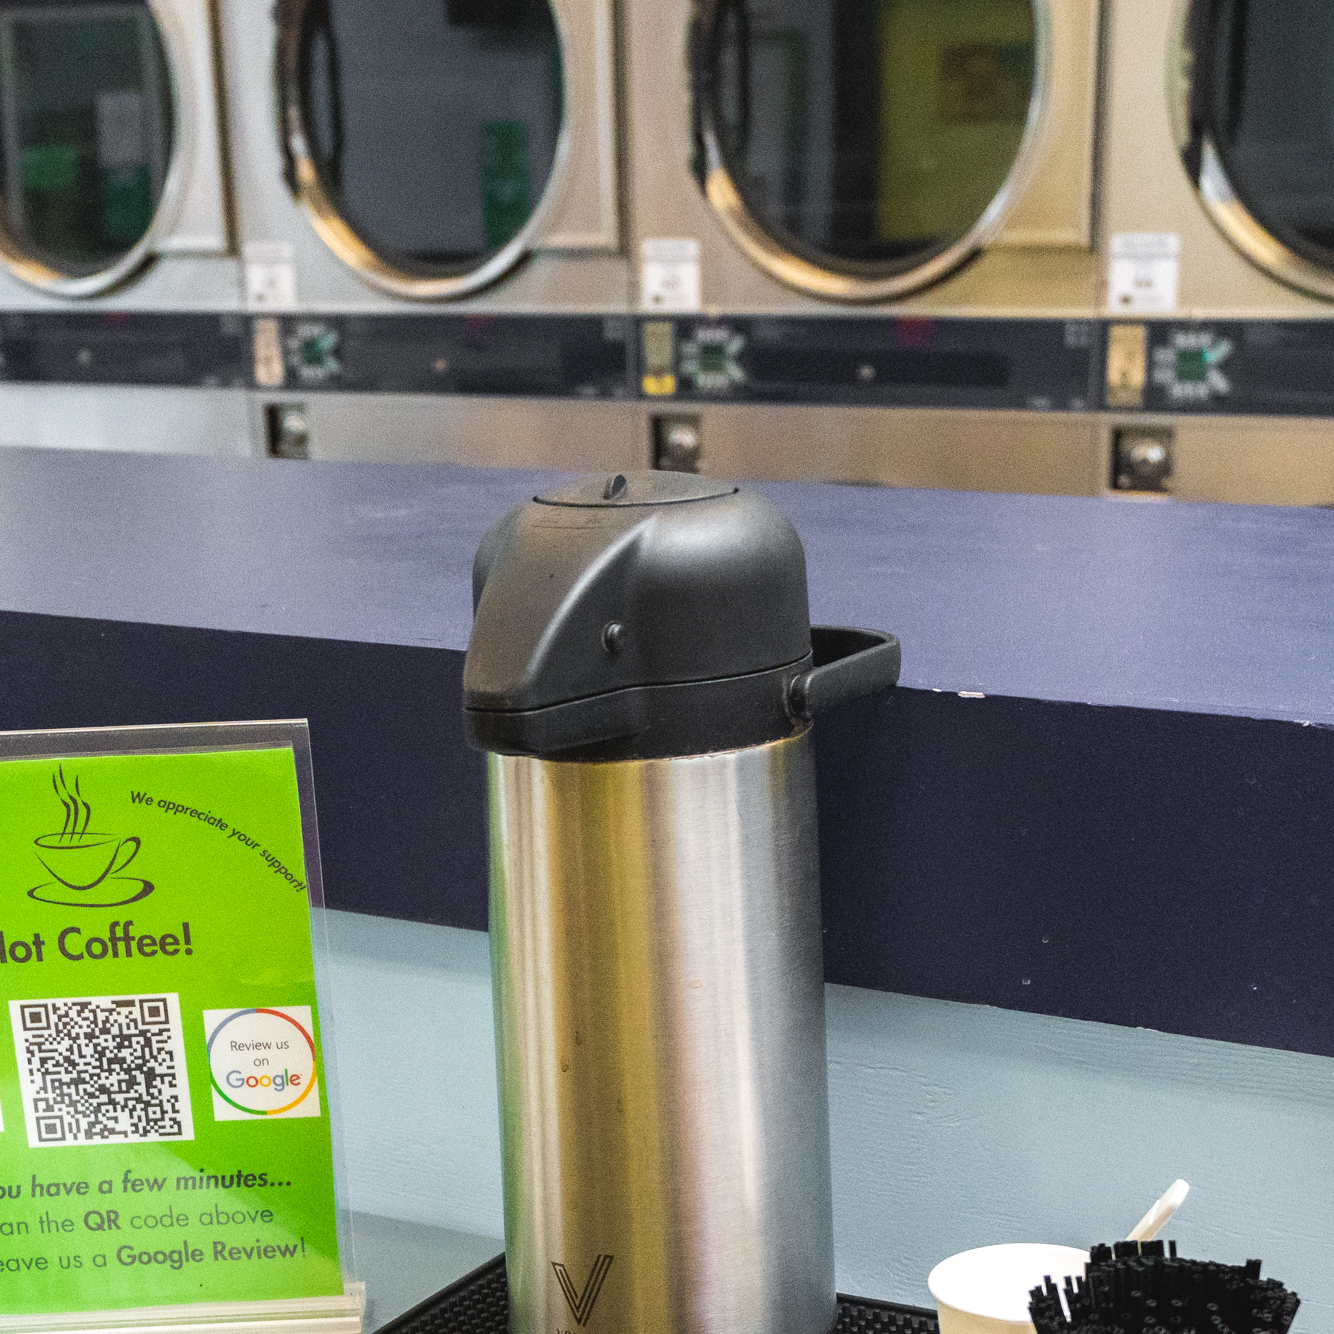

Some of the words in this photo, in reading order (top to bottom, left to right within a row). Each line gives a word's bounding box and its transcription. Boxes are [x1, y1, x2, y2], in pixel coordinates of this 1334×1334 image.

[130, 790, 154, 806] We
[157, 798, 229, 832] appreciate
[227, 828, 261, 850] your
[259, 849, 308, 893] support!
[57, 920, 194, 962] Coffee!
[230, 1039, 272, 1052] Review
[276, 1040, 290, 1050] us
[253, 1058, 269, 1067] on
[226, 1068, 301, 1092] Google
[30, 1174, 90, 1198] have
[98, 1179, 113, 1195] a
[122, 1169, 167, 1193] few
[175, 1167, 292, 1191] minutes...
[39, 1210, 75, 1234] the
[83, 1209, 122, 1232] QR
[130, 1205, 189, 1229] code
[199, 1203, 274, 1226] above
[58, 1254, 83, 1270] us
[92, 1253, 107, 1268] a
[117, 1239, 204, 1270] Google
[212, 1236, 306, 1262] Review!
